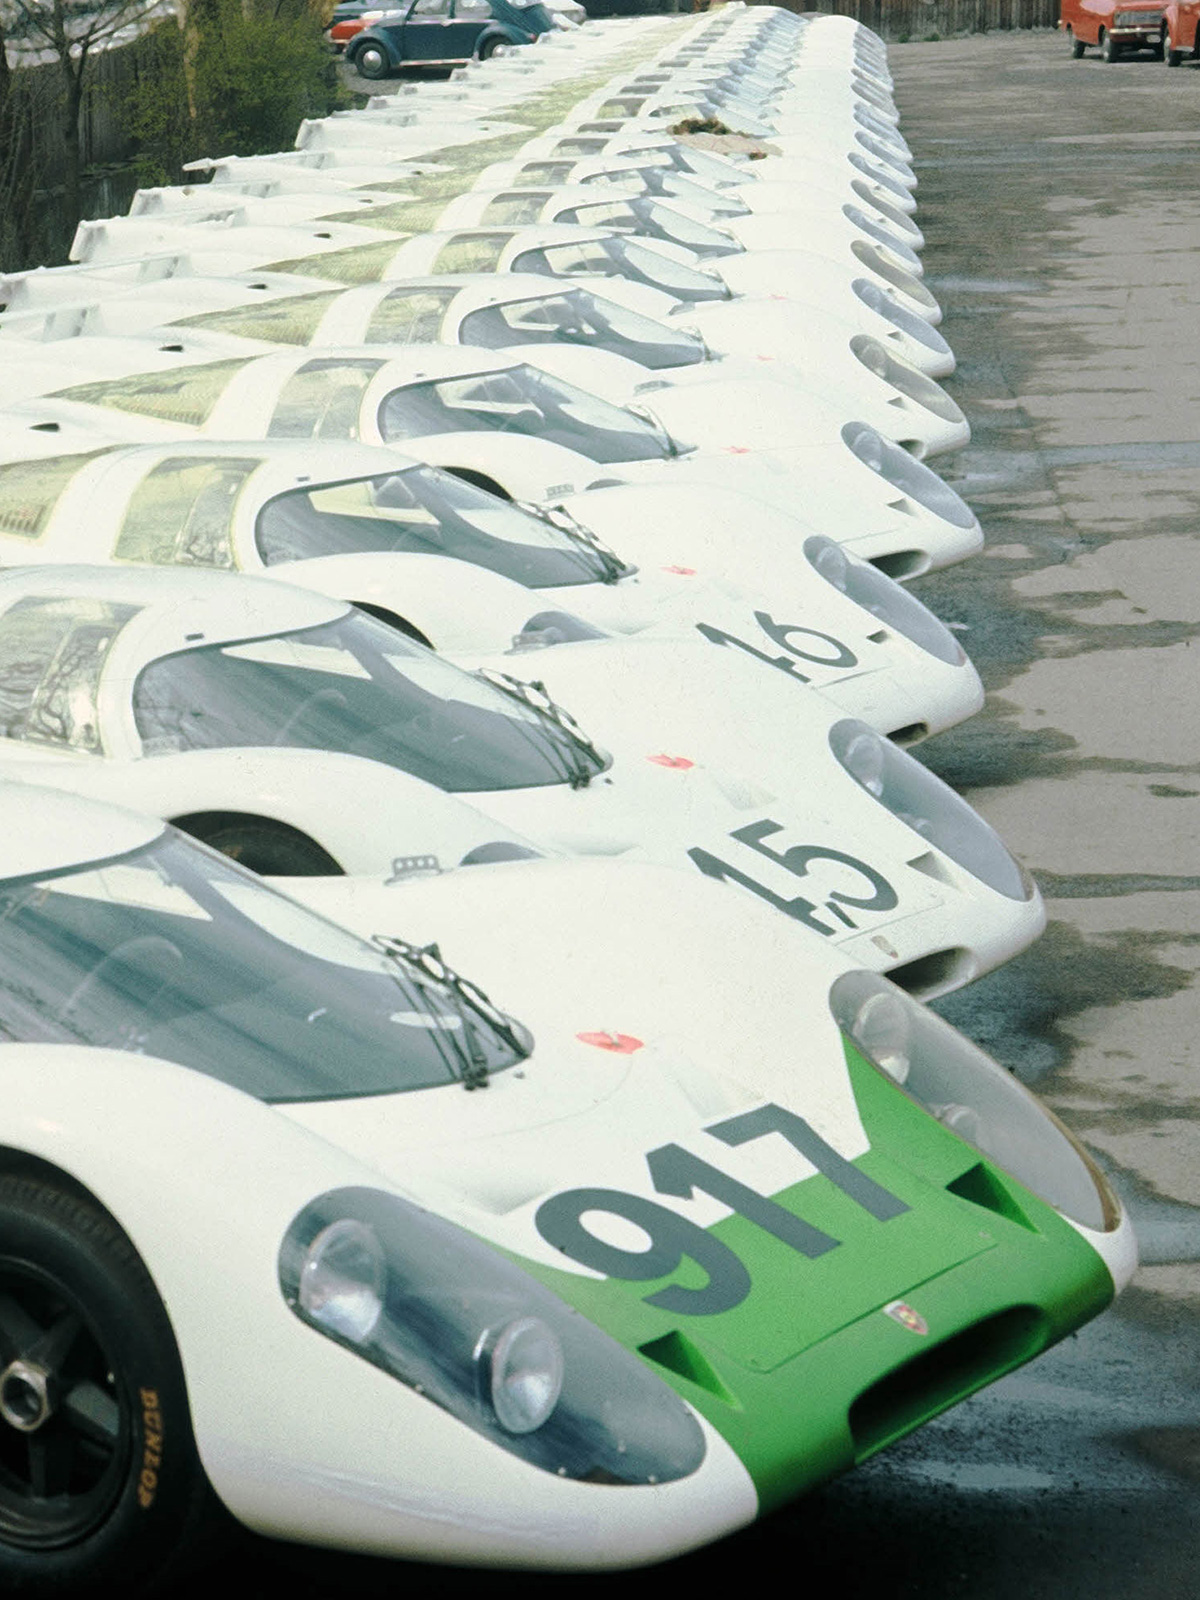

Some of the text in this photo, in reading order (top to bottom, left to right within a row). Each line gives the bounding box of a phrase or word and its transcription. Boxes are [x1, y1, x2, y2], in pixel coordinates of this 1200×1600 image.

[696, 610, 858, 683] 16
[687, 818, 899, 936] 15
[534, 1102, 912, 1316] 917
[139, 1387, 164, 1508] DUNLOP
